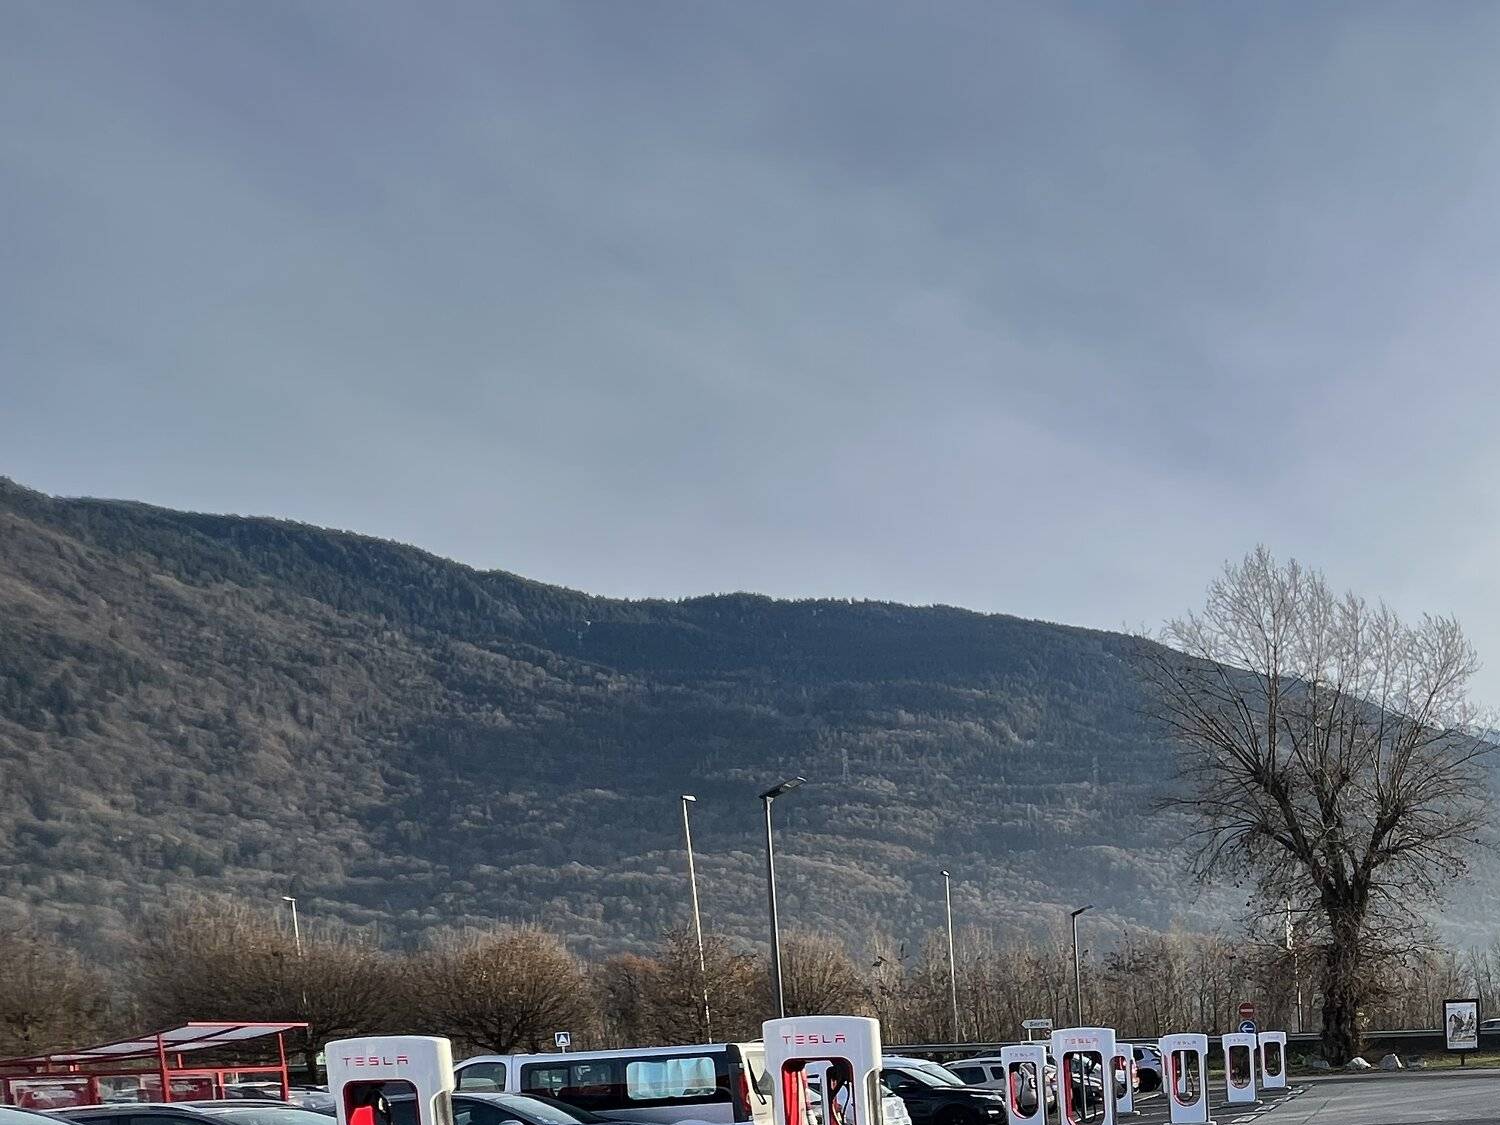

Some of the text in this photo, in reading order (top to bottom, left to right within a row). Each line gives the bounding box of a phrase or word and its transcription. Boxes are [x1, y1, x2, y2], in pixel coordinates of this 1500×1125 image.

[783, 1034, 846, 1045] TESLA
[1064, 1037, 1099, 1045] TESLA
[342, 1055, 409, 1066] TESLA
